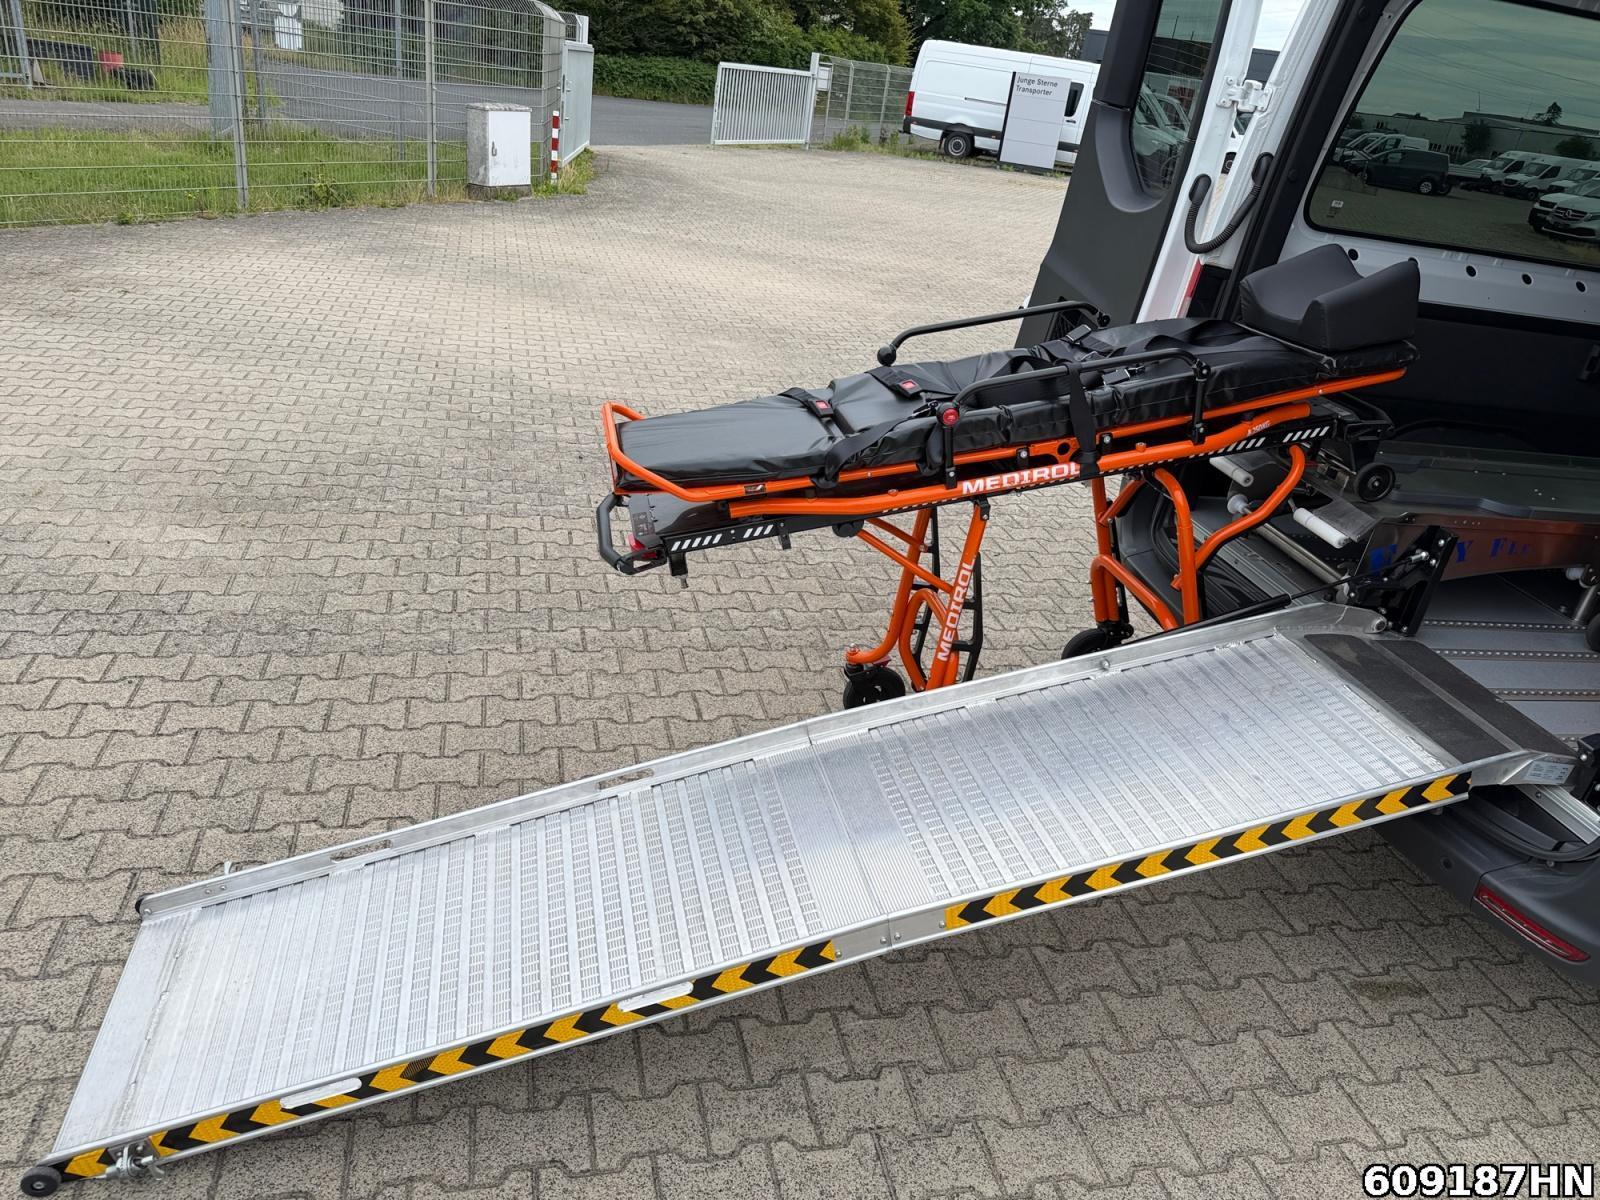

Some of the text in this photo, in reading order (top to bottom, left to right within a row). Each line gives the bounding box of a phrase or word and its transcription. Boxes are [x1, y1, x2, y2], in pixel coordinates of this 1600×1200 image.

[1015, 85, 1053, 96] Transporter
[1016, 76, 1058, 88] Junge Sterne
[961, 461, 1081, 495] MEDIROL
[937, 558, 976, 662] MEDIROL
